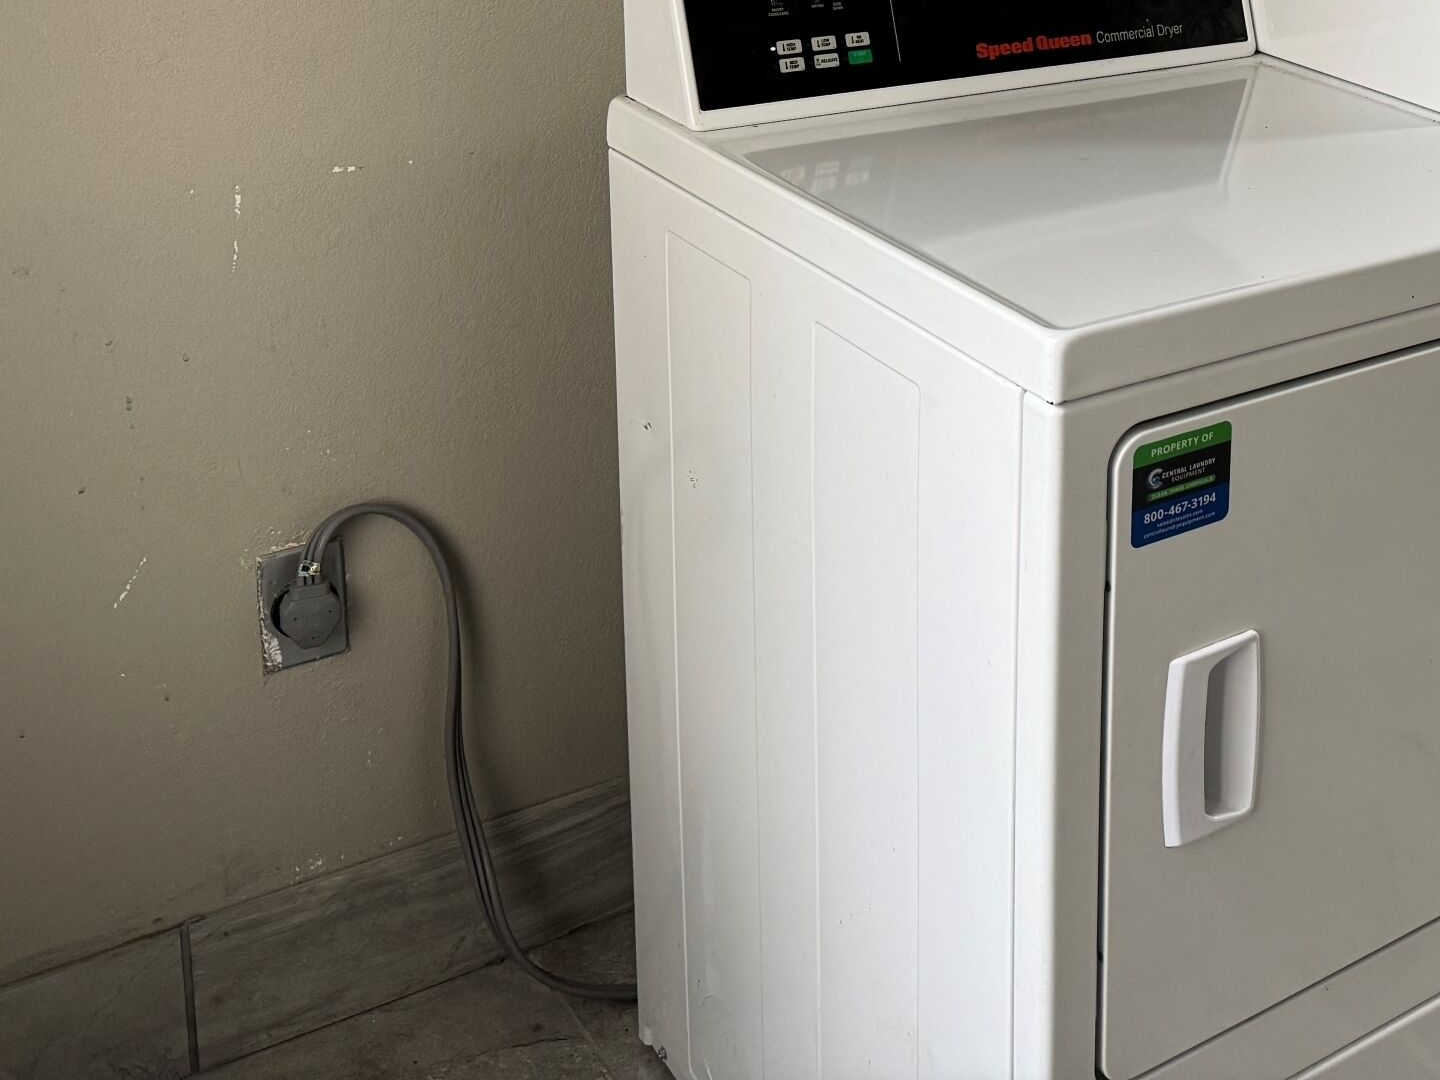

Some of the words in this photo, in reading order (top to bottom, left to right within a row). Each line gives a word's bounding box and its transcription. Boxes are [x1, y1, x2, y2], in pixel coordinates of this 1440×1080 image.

[1096, 25, 1154, 44] Commercial
[1157, 23, 1183, 40] Dryer
[976, 37, 1034, 60] Speed
[1036, 33, 1093, 50] Queen
[1151, 436, 1200, 457] PROPERTY
[1201, 431, 1214, 443] OF
[1162, 466, 1187, 479] CENTRAL
[1189, 457, 1216, 470] LAUNDRY
[1171, 467, 1206, 482] EQUIPMENT
[1144, 492, 1216, 524] 800-467-3194
